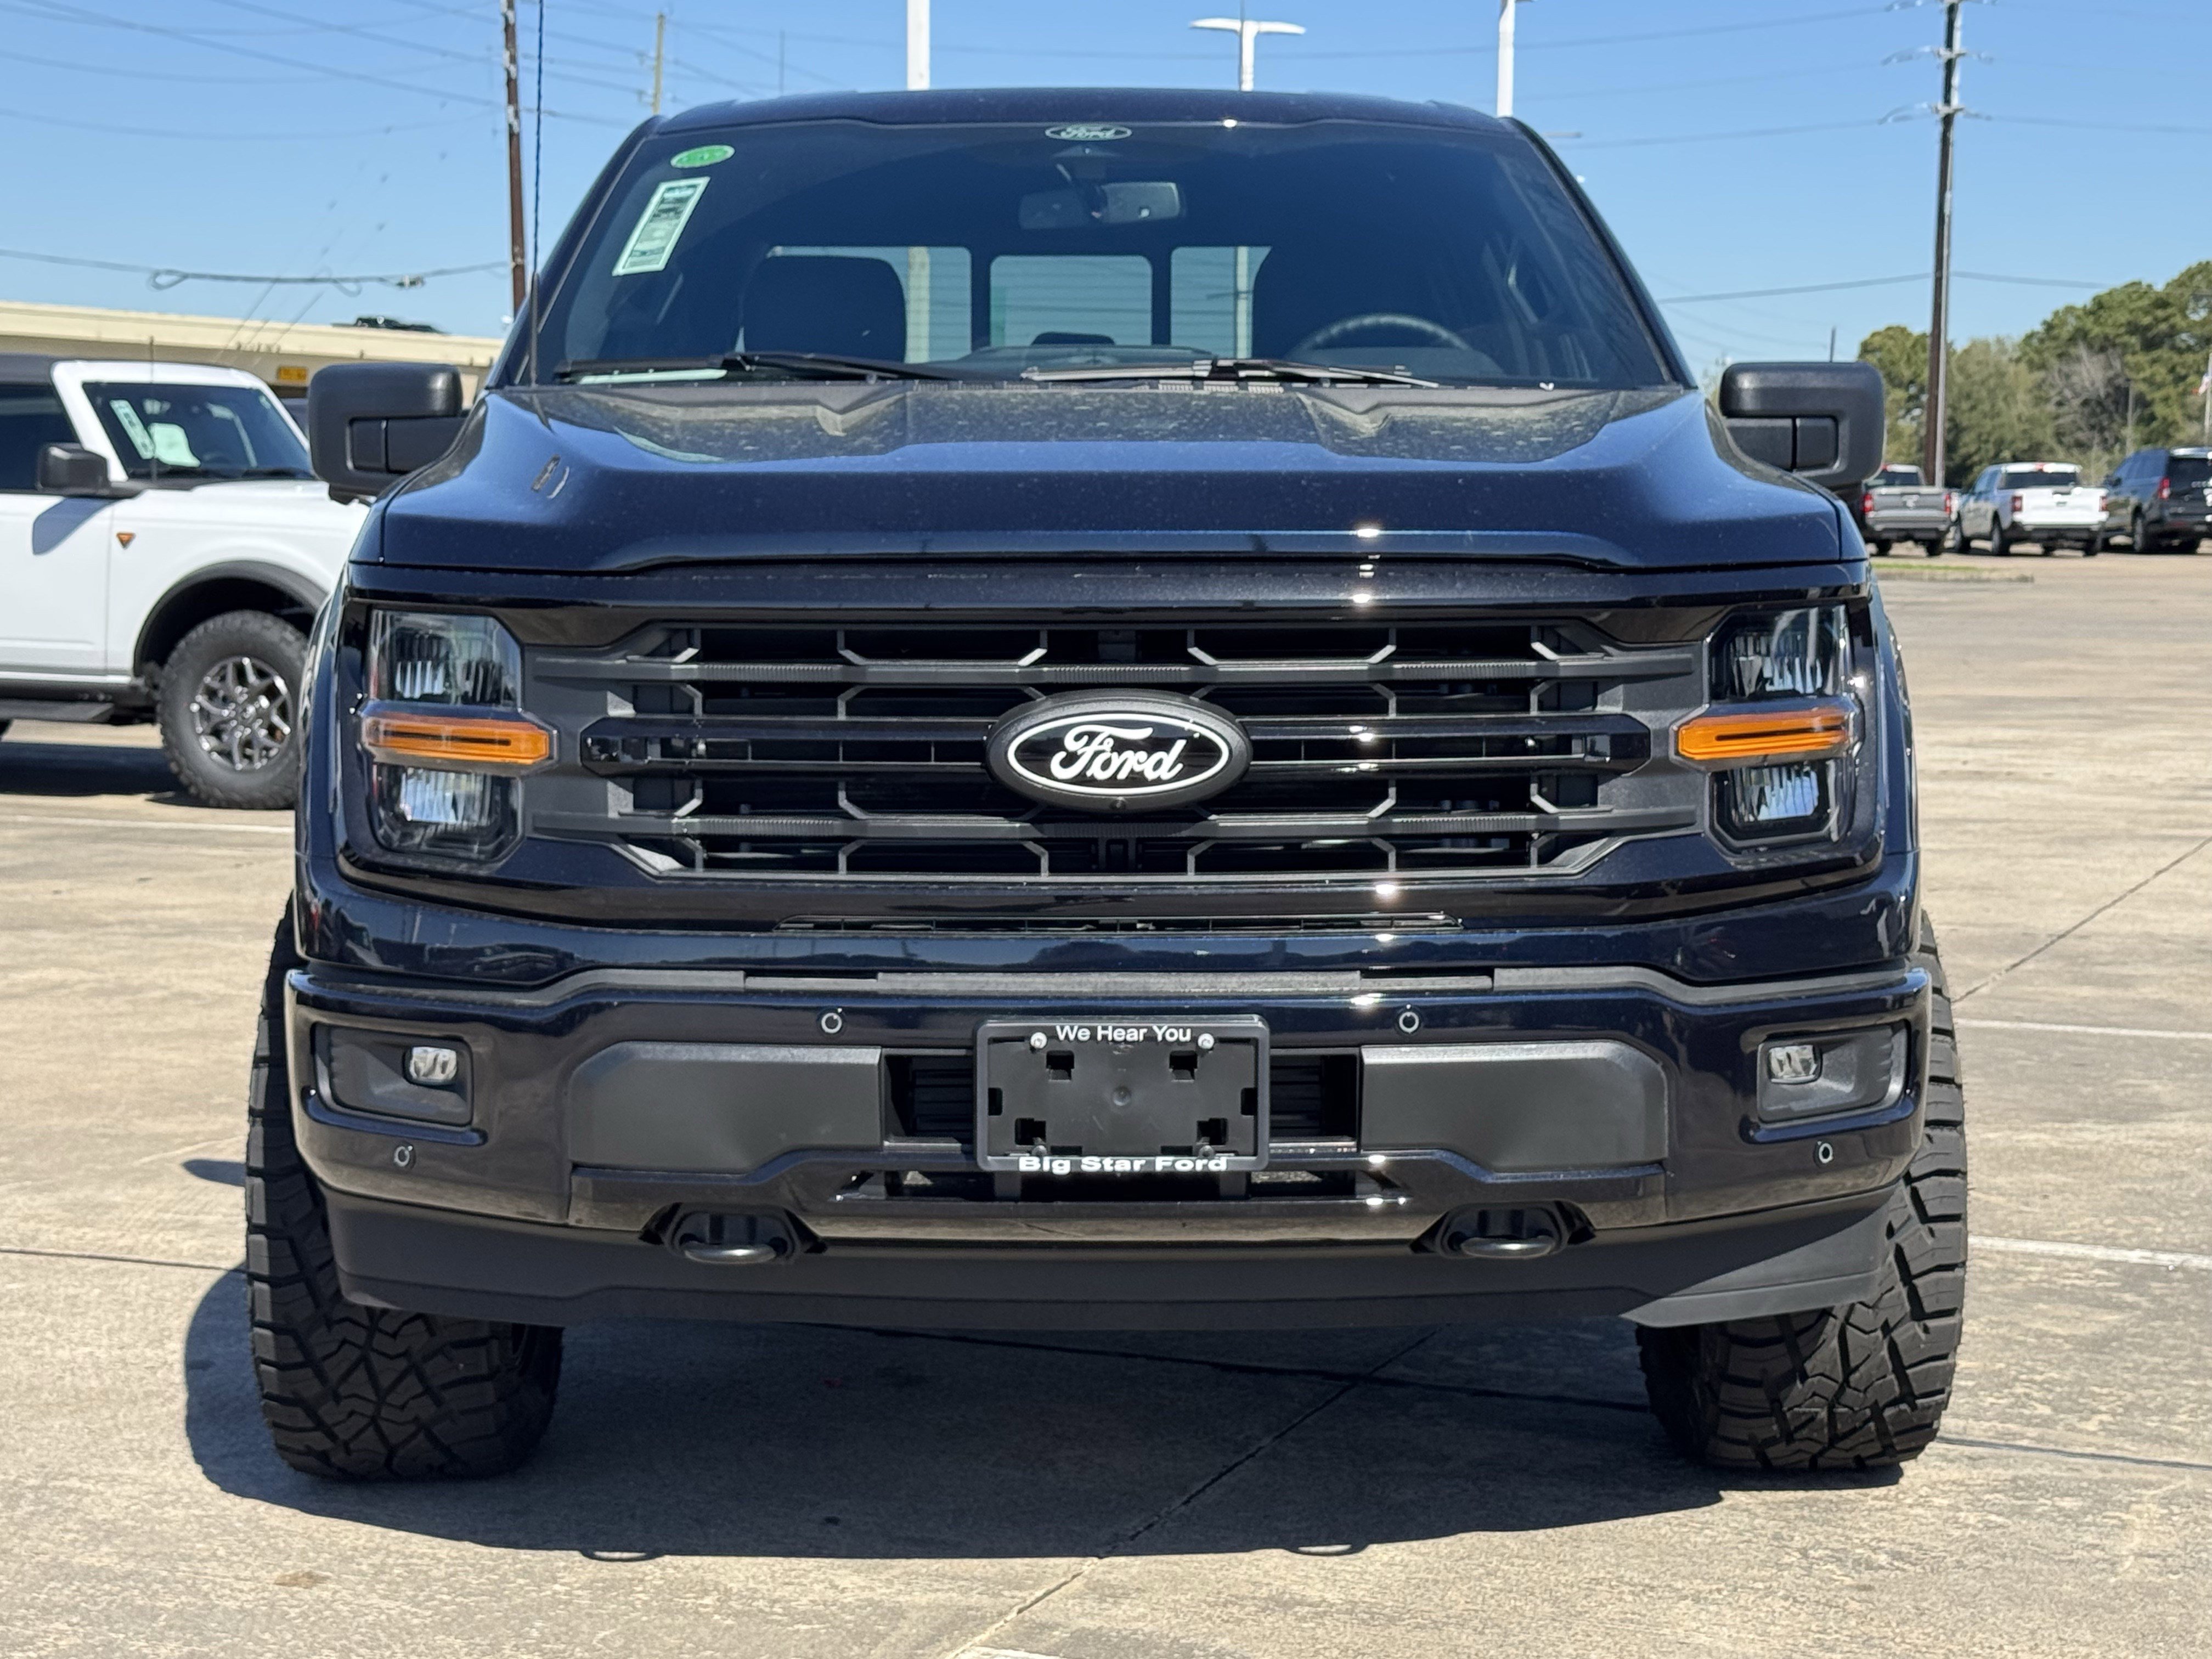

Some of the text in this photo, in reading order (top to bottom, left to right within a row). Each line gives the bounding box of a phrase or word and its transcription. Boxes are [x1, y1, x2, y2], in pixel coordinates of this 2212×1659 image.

[1060, 125, 1116, 138] Ford
[1050, 724, 1187, 782] Ford
[1056, 1025, 1192, 1042] We Hear You
[1018, 1155, 1228, 1175] Big Star Ford
